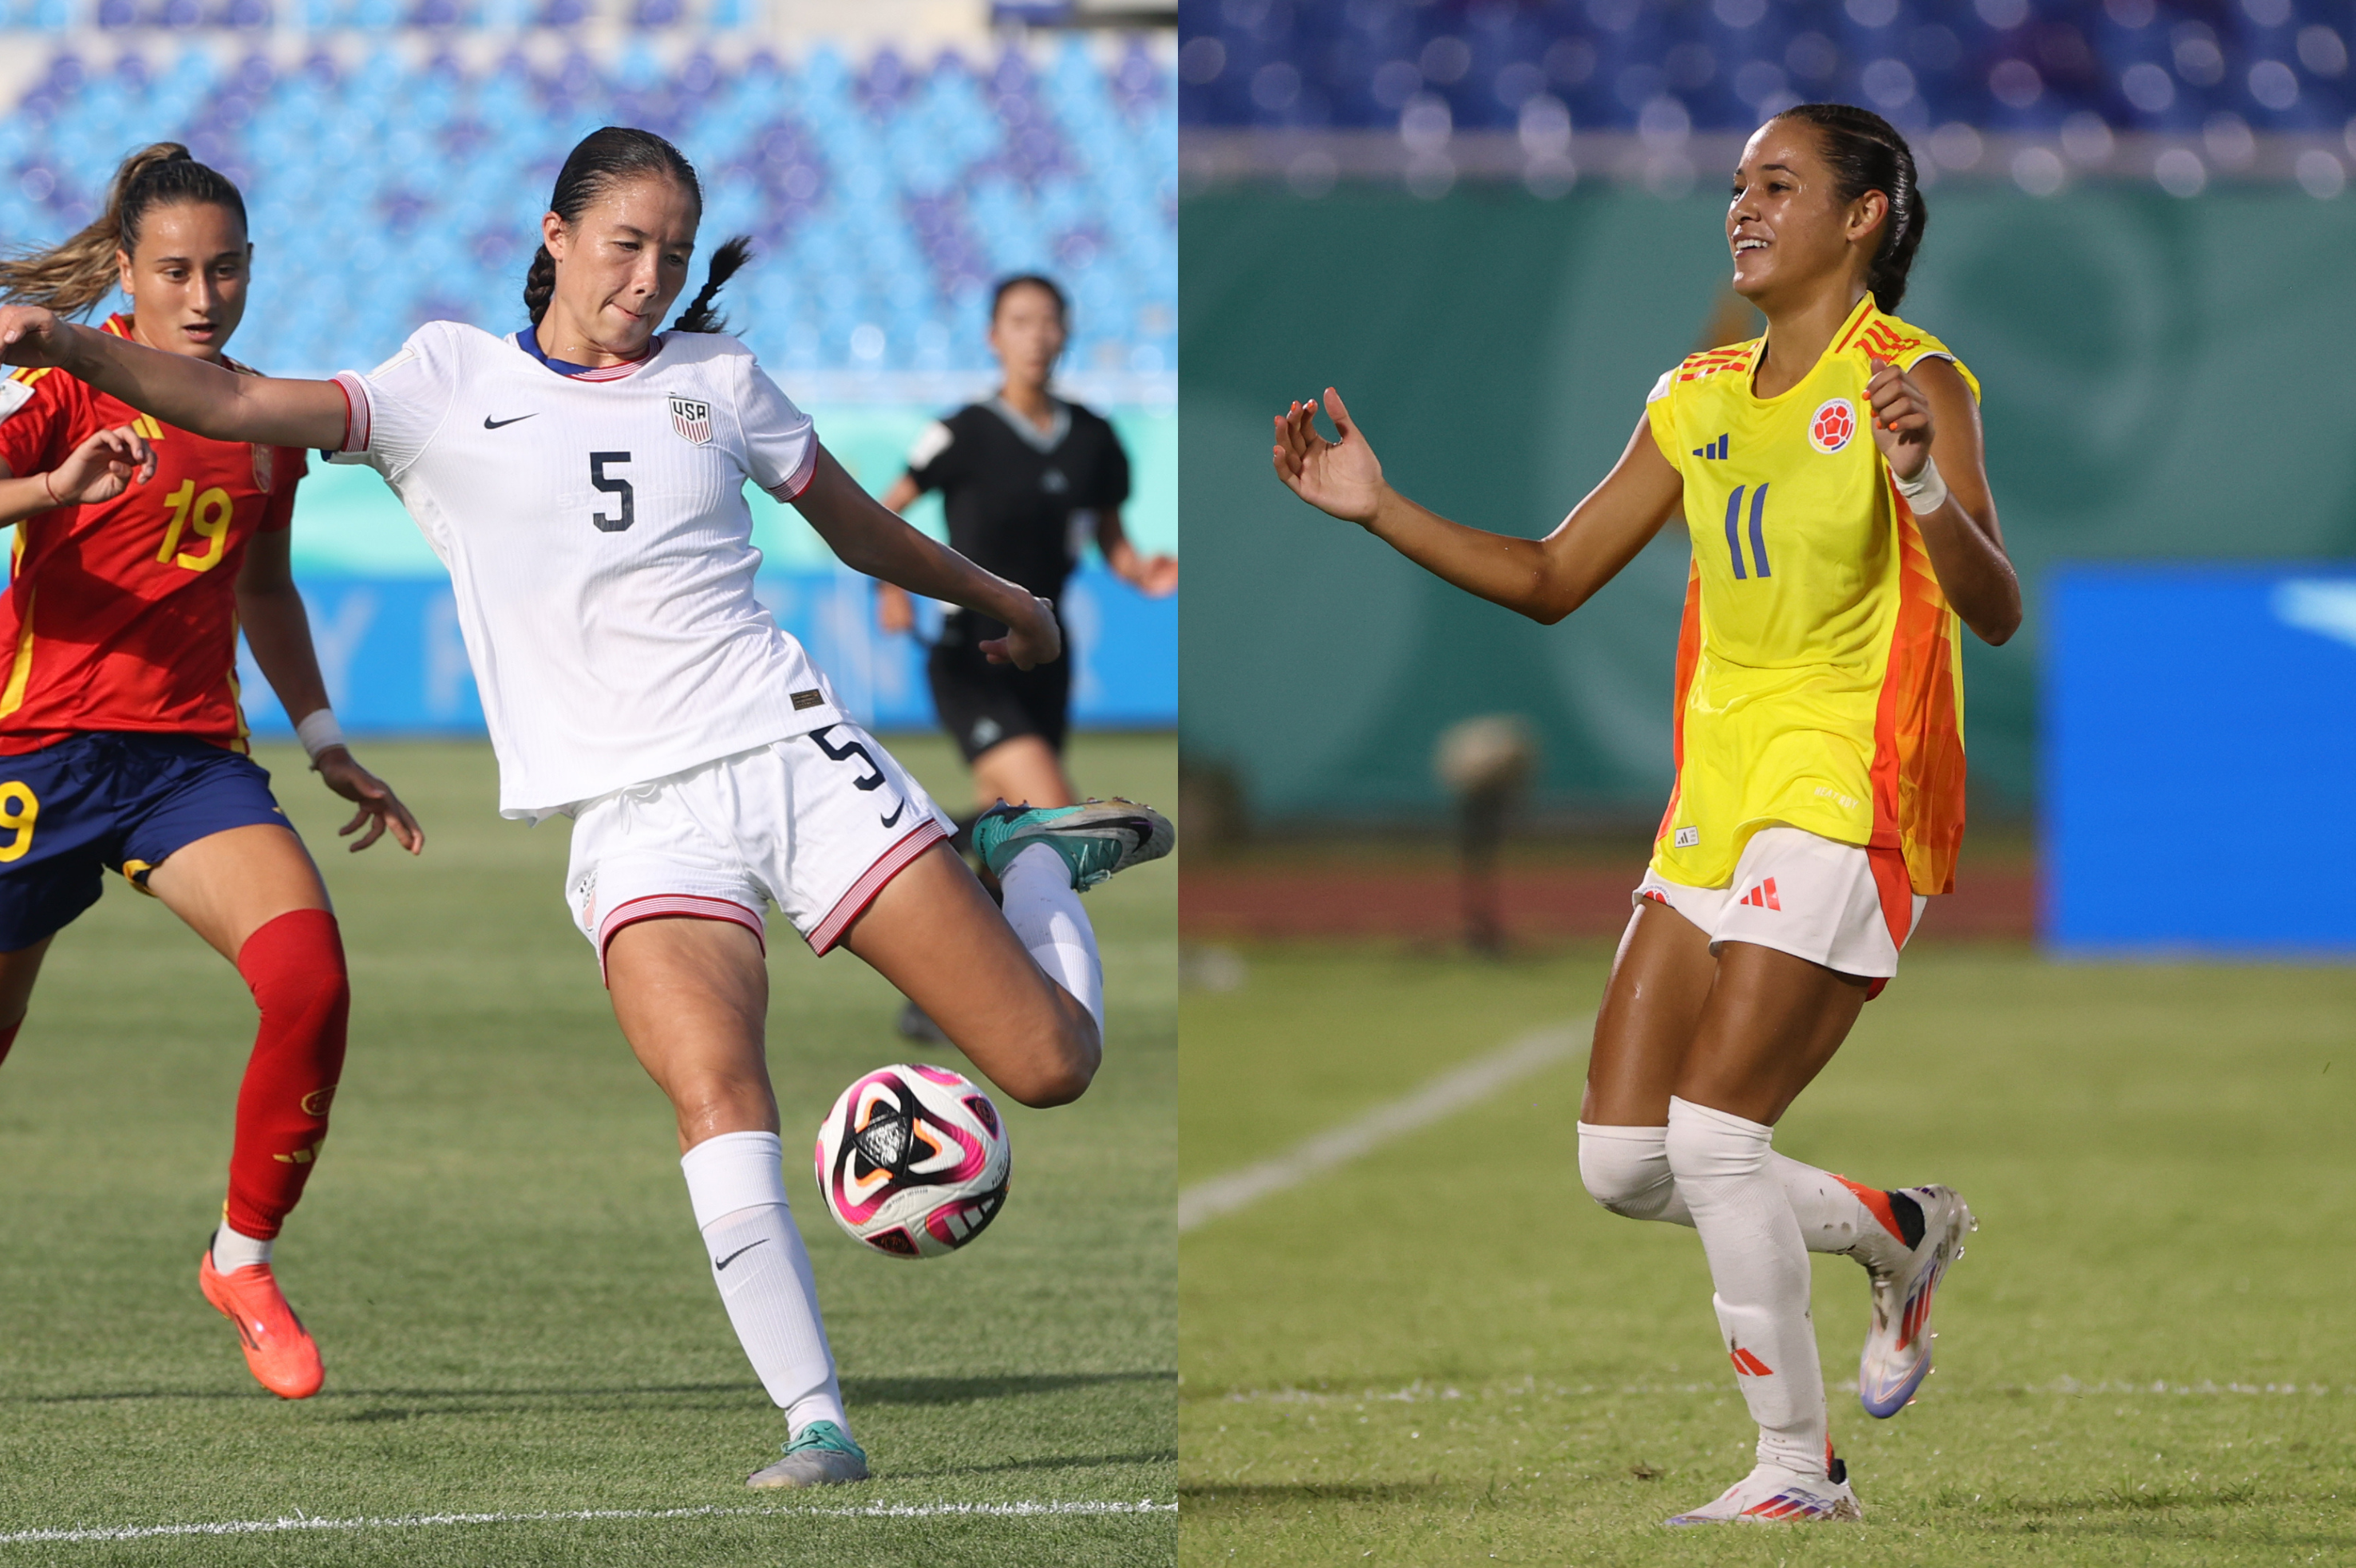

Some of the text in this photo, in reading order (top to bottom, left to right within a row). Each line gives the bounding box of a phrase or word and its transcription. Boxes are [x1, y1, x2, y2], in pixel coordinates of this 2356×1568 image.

[673, 401, 706, 421] USA
[156, 478, 234, 572] 19
[589, 451, 634, 533] 5
[1725, 482, 1772, 580] 11
[808, 722, 887, 792] 5
[1814, 786, 1860, 810] HEAT RDY
